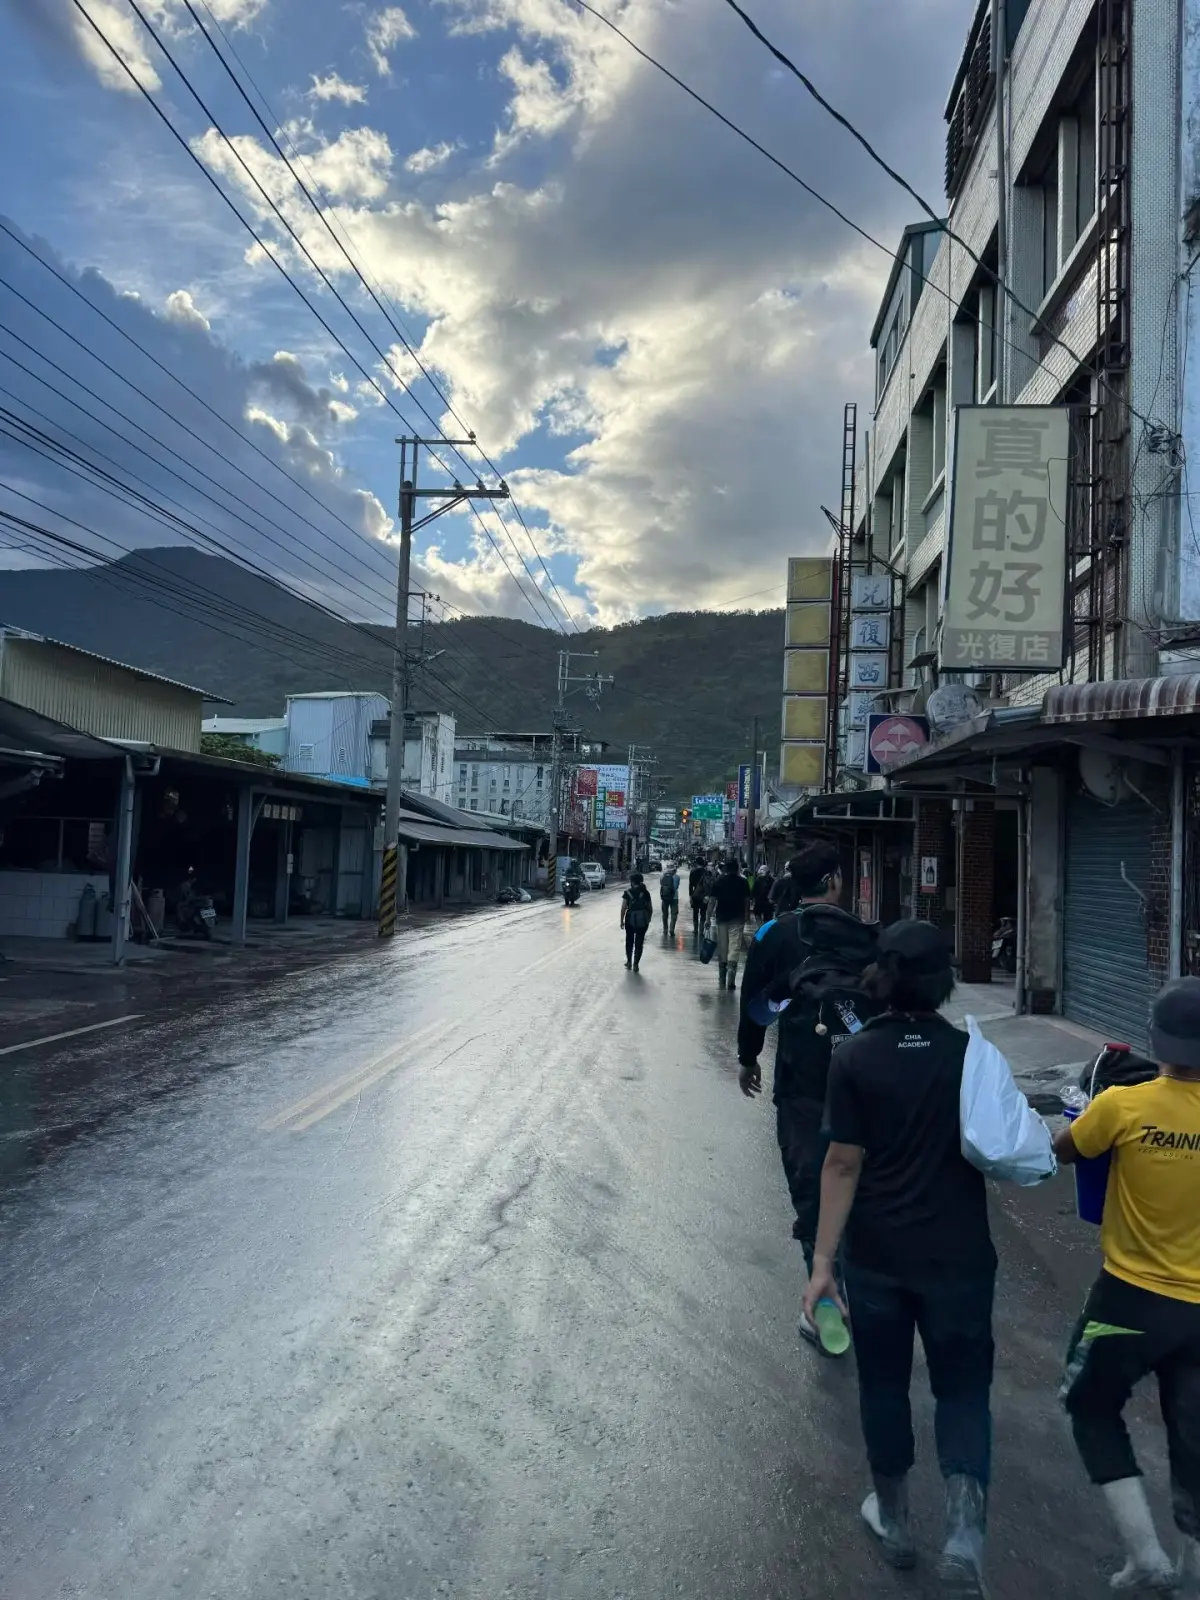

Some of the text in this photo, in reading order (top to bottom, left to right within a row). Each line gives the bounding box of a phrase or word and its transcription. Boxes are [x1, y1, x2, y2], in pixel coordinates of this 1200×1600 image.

[966, 417, 1050, 623] 真的好
[853, 585, 885, 763] 光復西藥
[957, 634, 1050, 662] 光復店
